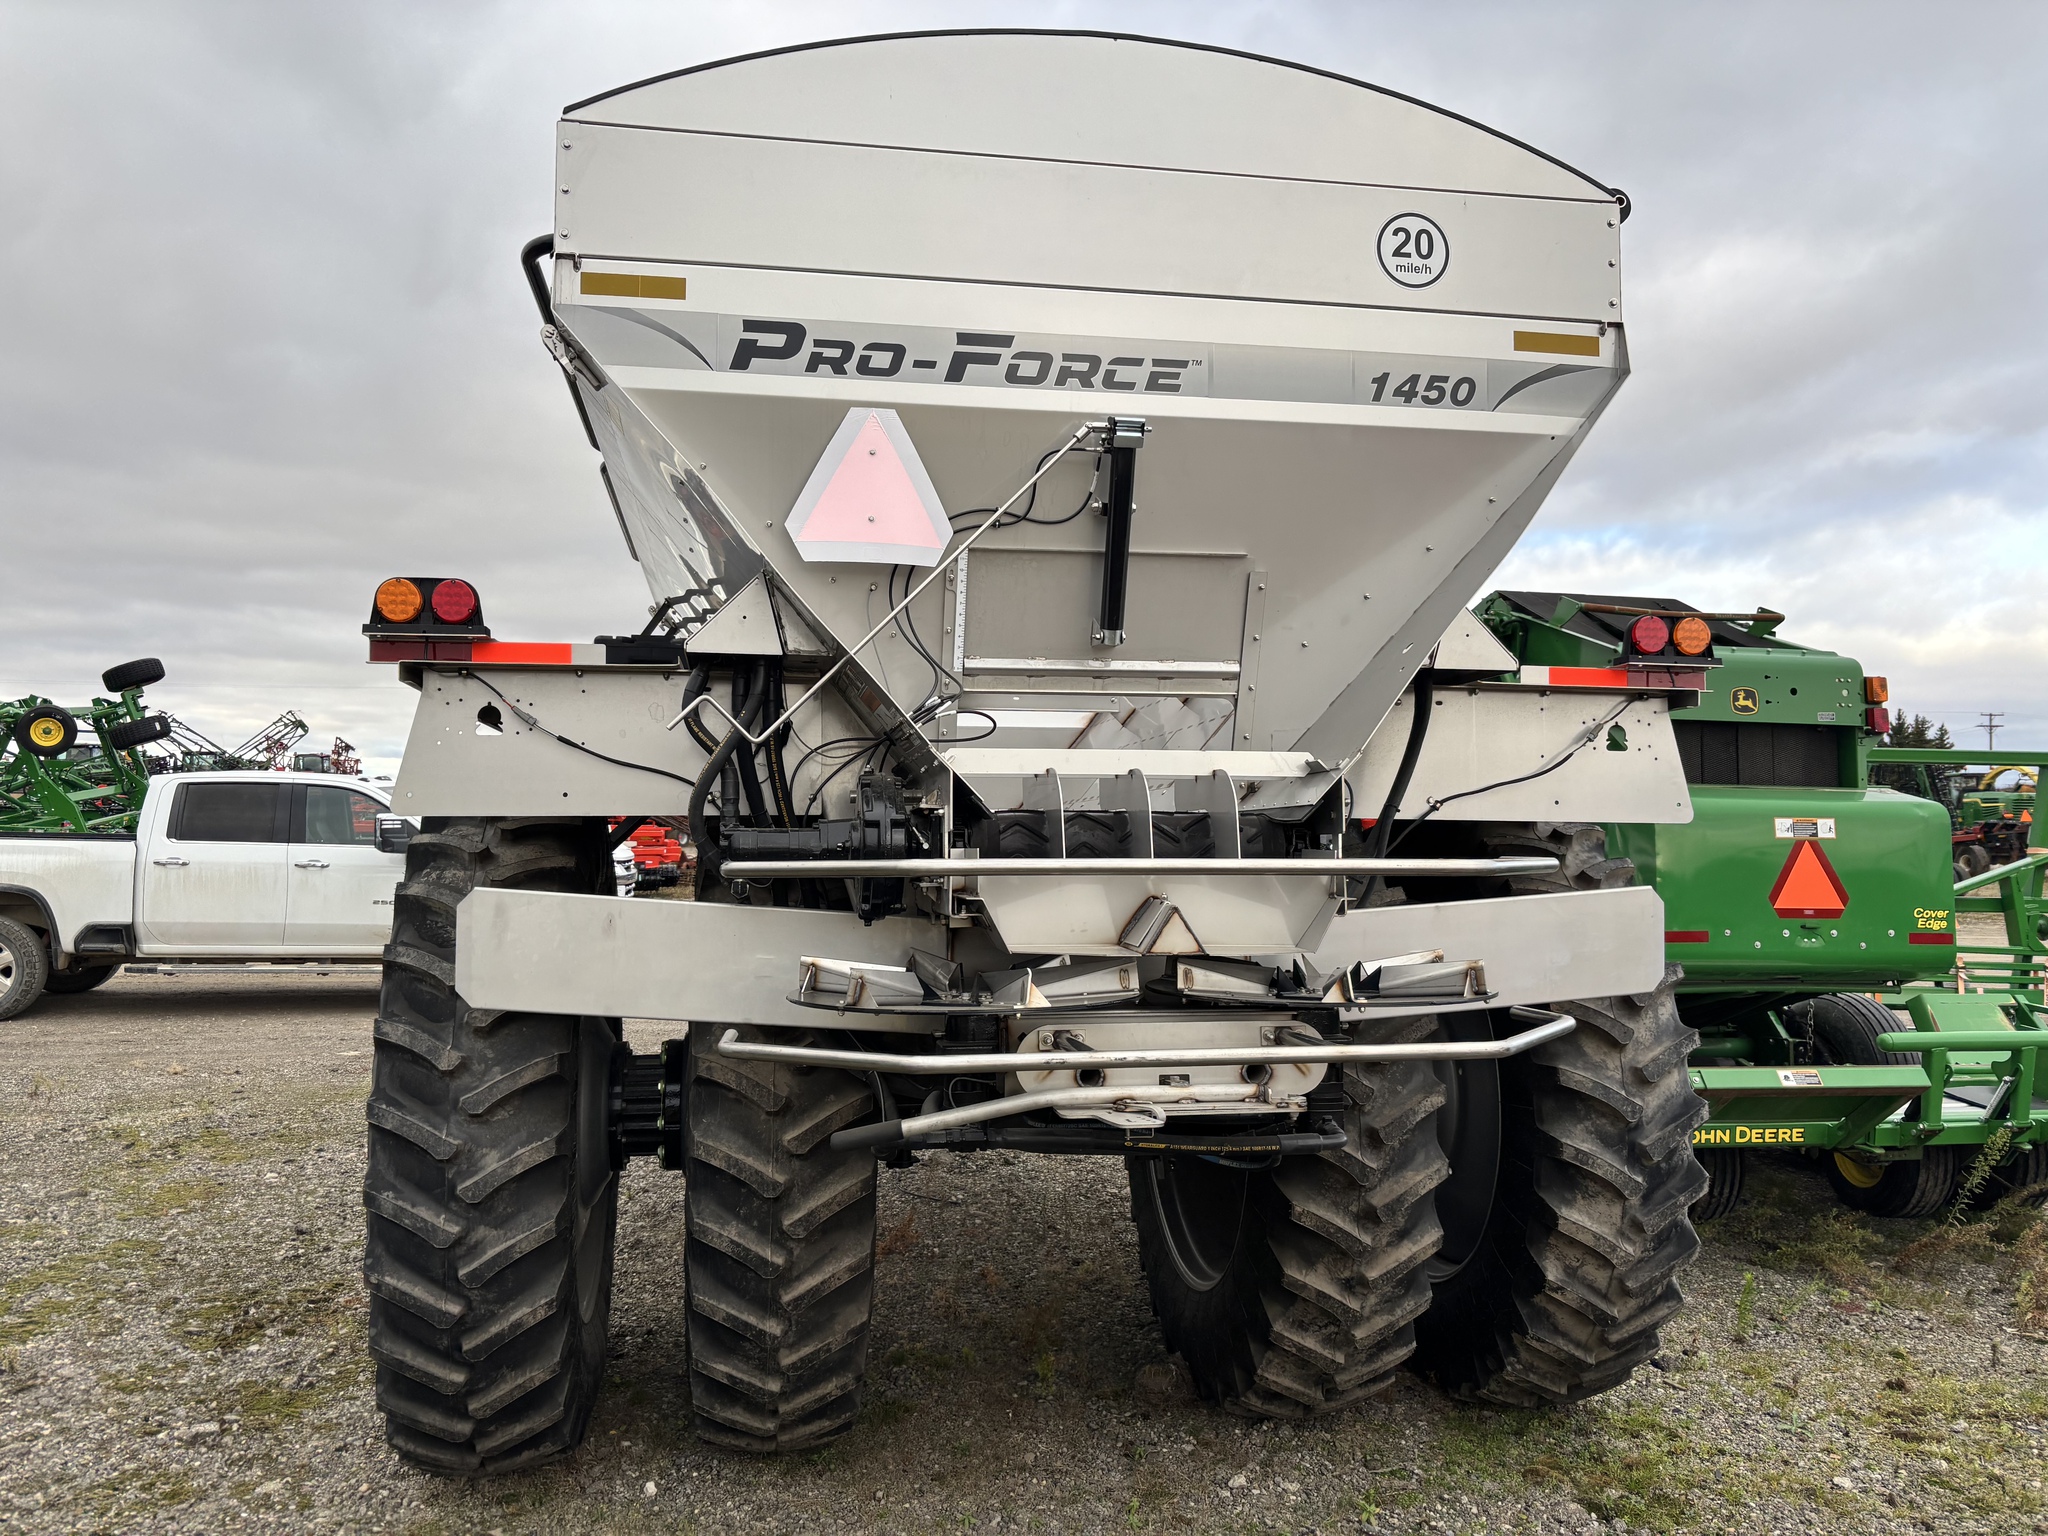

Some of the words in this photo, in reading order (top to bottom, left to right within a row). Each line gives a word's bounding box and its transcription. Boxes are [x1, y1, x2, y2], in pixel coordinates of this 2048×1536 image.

[1391, 227, 1434, 260] 20
[1395, 262, 1432, 275] mile/h
[1370, 372, 1476, 407] 1450
[1914, 908, 1950, 918] Cover
[1917, 918, 1948, 930] Edge
[1692, 1129, 1730, 1144] OHN
[1735, 1126, 1805, 1143] DEERE
